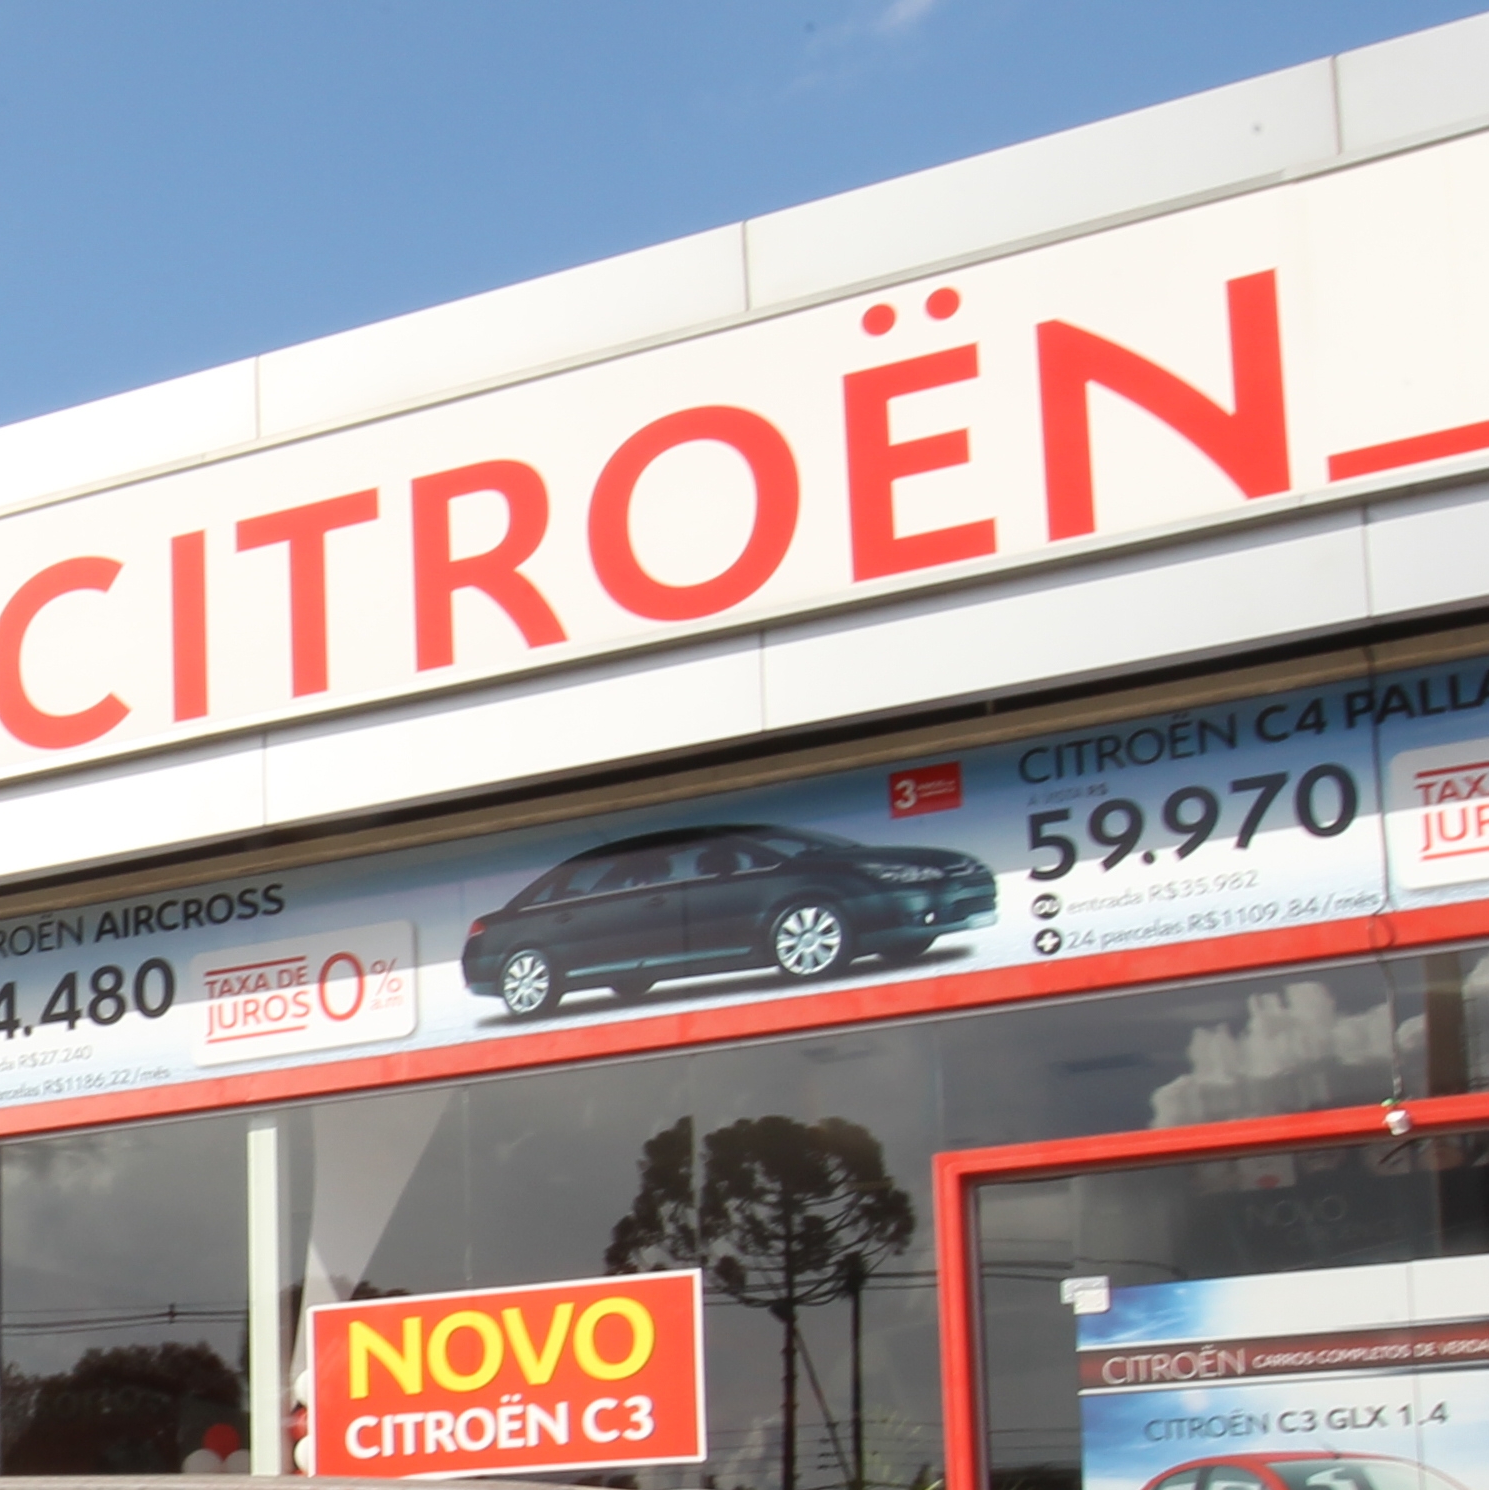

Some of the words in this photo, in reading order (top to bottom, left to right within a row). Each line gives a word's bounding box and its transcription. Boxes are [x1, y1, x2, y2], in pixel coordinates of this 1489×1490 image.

[1019, 711, 1238, 784] CITROËN
[1255, 701, 1327, 743] C4
[1027, 762, 1359, 882] 59.970
[94, 883, 286, 941] AIRCROSS
[1067, 887, 1144, 914] entrada
[1148, 869, 1260, 902] R$35.982
[1067, 929, 1096, 950] 24
[1100, 916, 1185, 950] parcelas
[204, 971, 270, 999] TAXA
[276, 964, 311, 989] DE
[206, 989, 312, 1038] JUROS
[349, 1297, 655, 1399] NOVO
[1101, 1344, 1247, 1386] CITROËN
[1251, 1350, 1316, 1369] CARROS
[1316, 1343, 1411, 1365] COMPLETOS
[1413, 1341, 1437, 1358] DE
[345, 1395, 570, 1459] CITROËN
[582, 1394, 655, 1441] C3
[1143, 1408, 1269, 1442] CITROËN
[1275, 1408, 1318, 1434] C3
[1325, 1405, 1390, 1431] GLX
[1397, 1401, 1450, 1426] 1.4
